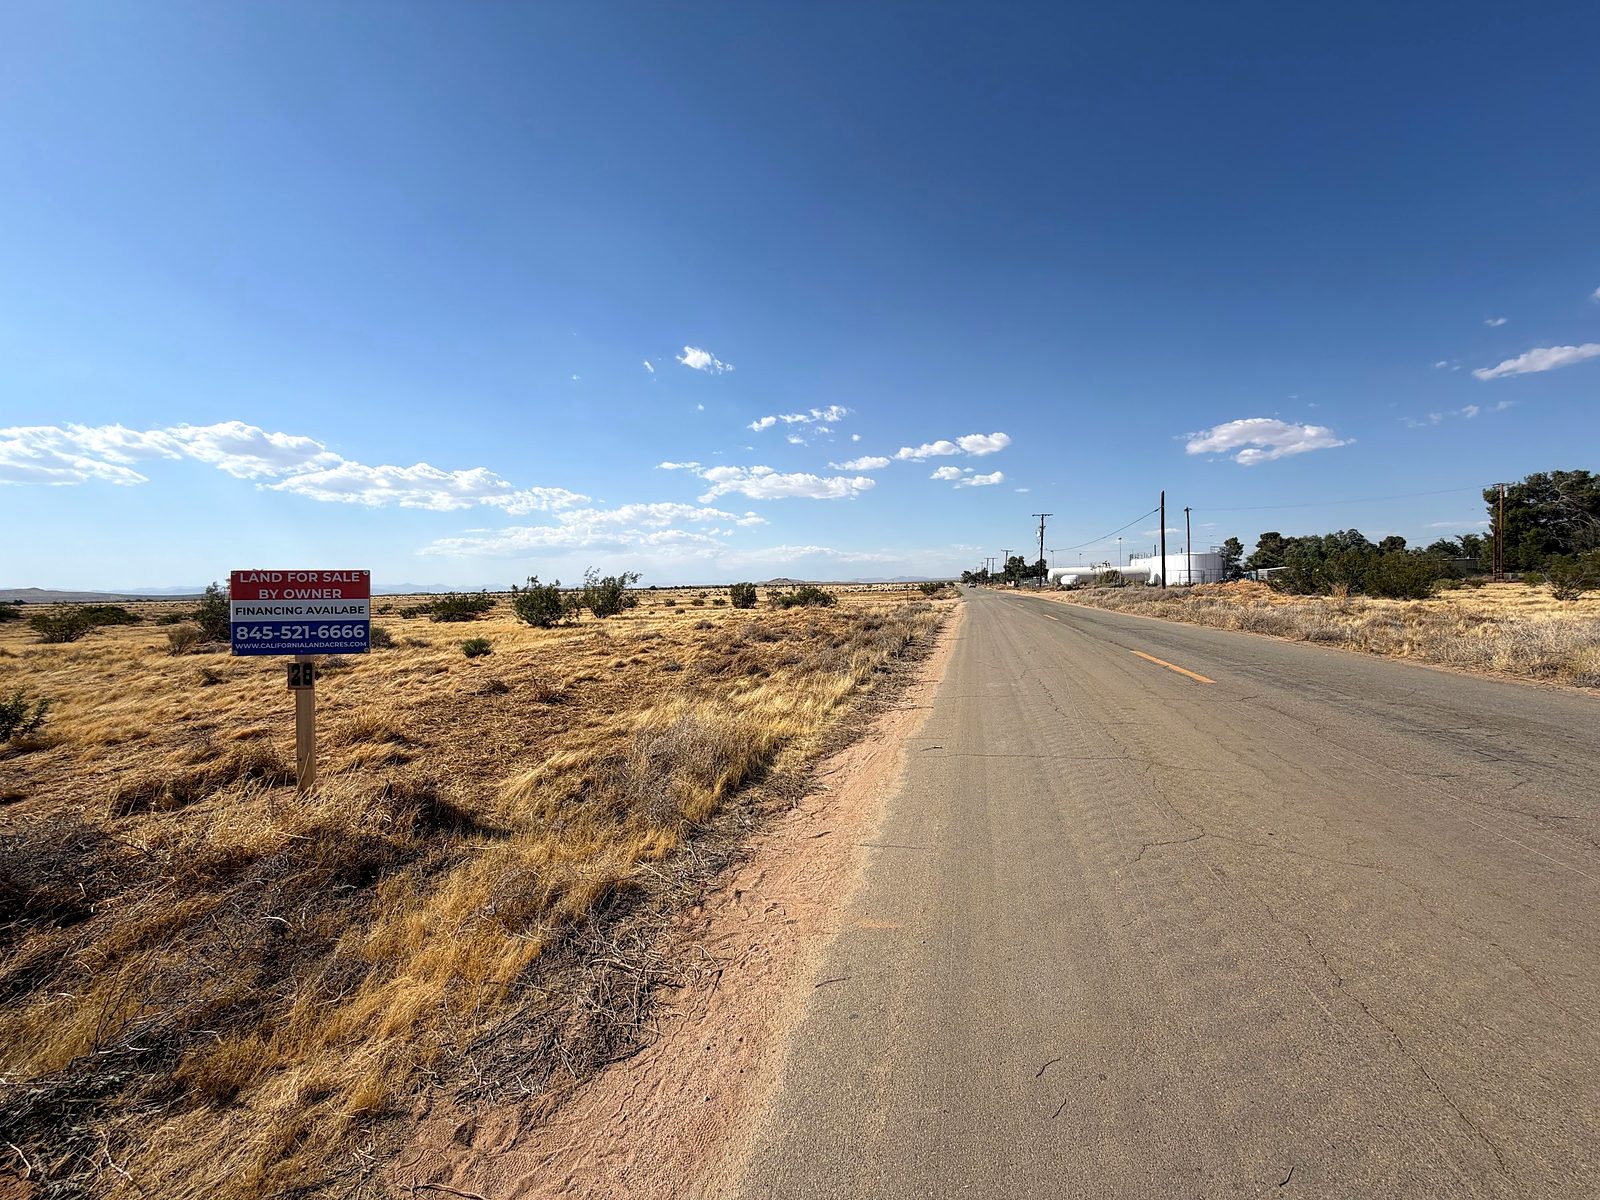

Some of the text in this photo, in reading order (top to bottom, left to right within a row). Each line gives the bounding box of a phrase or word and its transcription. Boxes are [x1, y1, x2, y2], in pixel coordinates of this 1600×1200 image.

[240, 572, 360, 583] LAND FOR SALE
[258, 588, 342, 599] BY OWNER
[235, 605, 365, 616] FINANCING AVAILABE
[236, 624, 365, 640] 845-521-6666
[235, 641, 367, 649] WWW.CALIFORNIALANDACRES.COM
